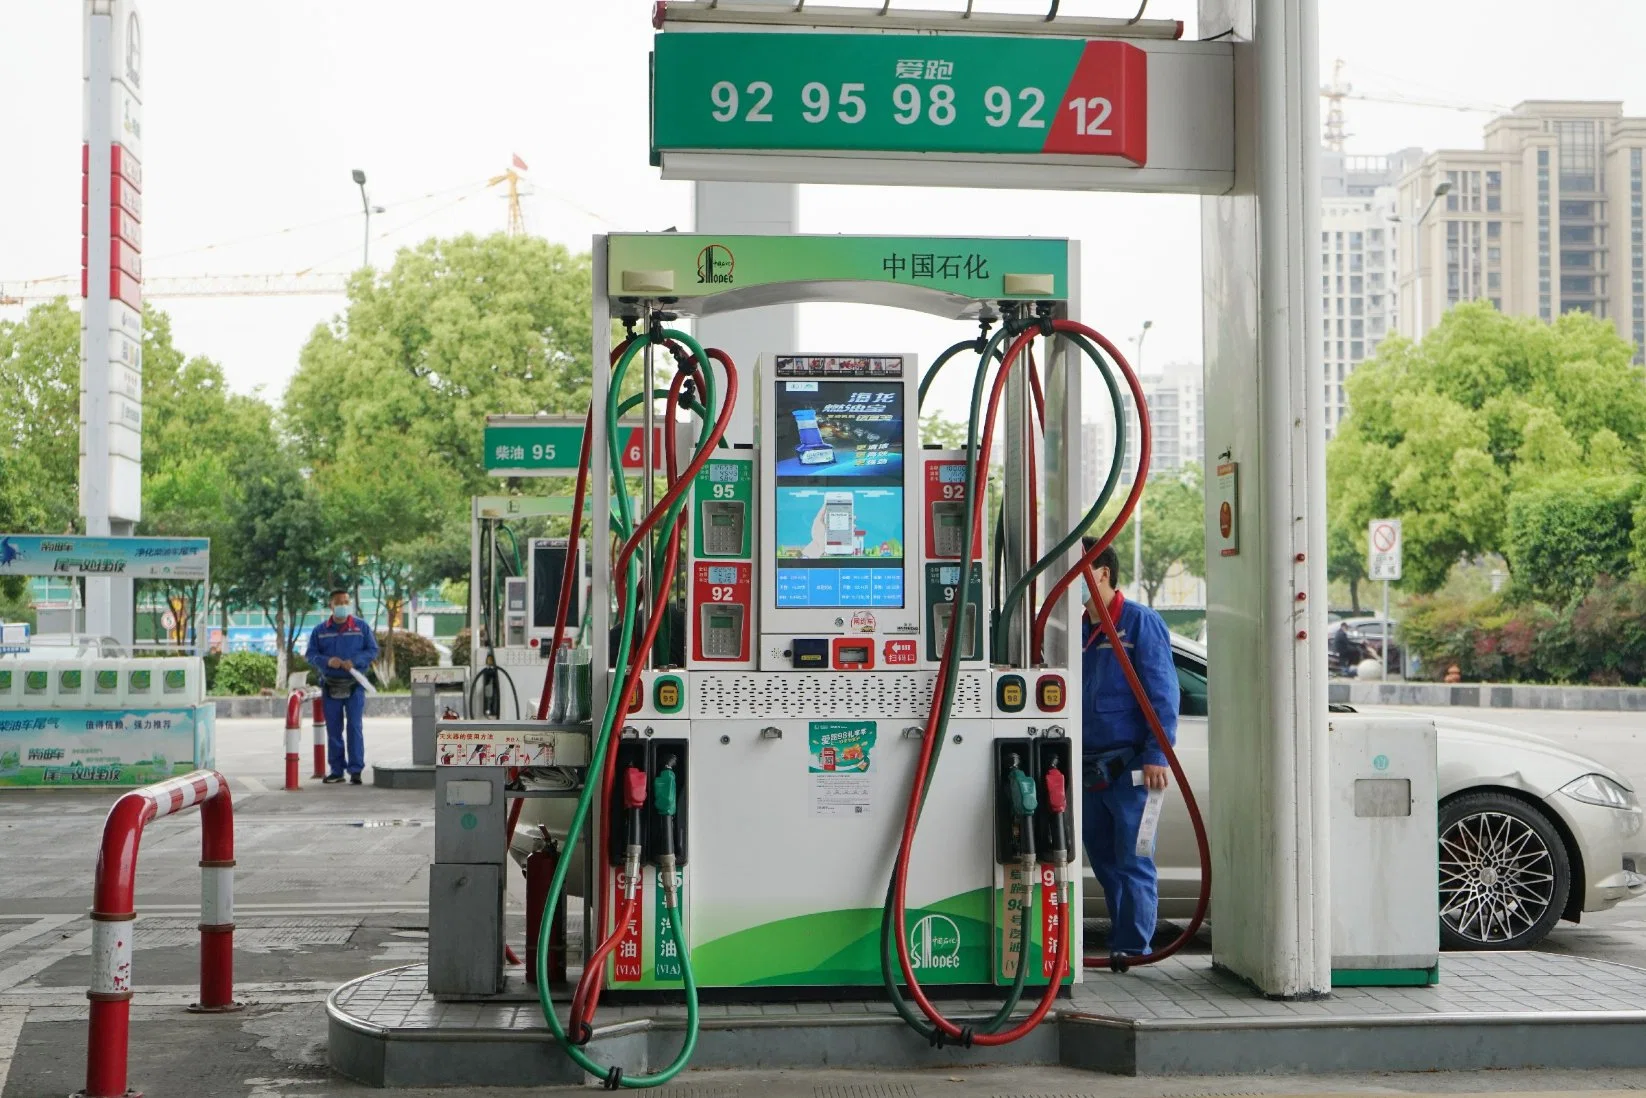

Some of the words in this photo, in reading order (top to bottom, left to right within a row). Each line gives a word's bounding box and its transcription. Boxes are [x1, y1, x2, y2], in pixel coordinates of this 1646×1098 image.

[895, 59, 954, 80] 爱跑
[711, 81, 773, 122] 92
[801, 82, 867, 124] 95
[892, 83, 957, 126] 98
[984, 86, 1045, 128] 92
[1068, 97, 1112, 136] 12
[883, 252, 990, 279] 中国石化
[496, 446, 525, 461] 柴油
[532, 445, 556, 460] 95
[630, 446, 641, 461] 6
[713, 484, 735, 498] 95
[943, 485, 964, 499] 92
[711, 586, 734, 601] 92
[888, 654, 915, 662] 扫码口
[86, 719, 172, 730] 值得信赖、强力推荐
[28, 748, 65, 760] 柴油车
